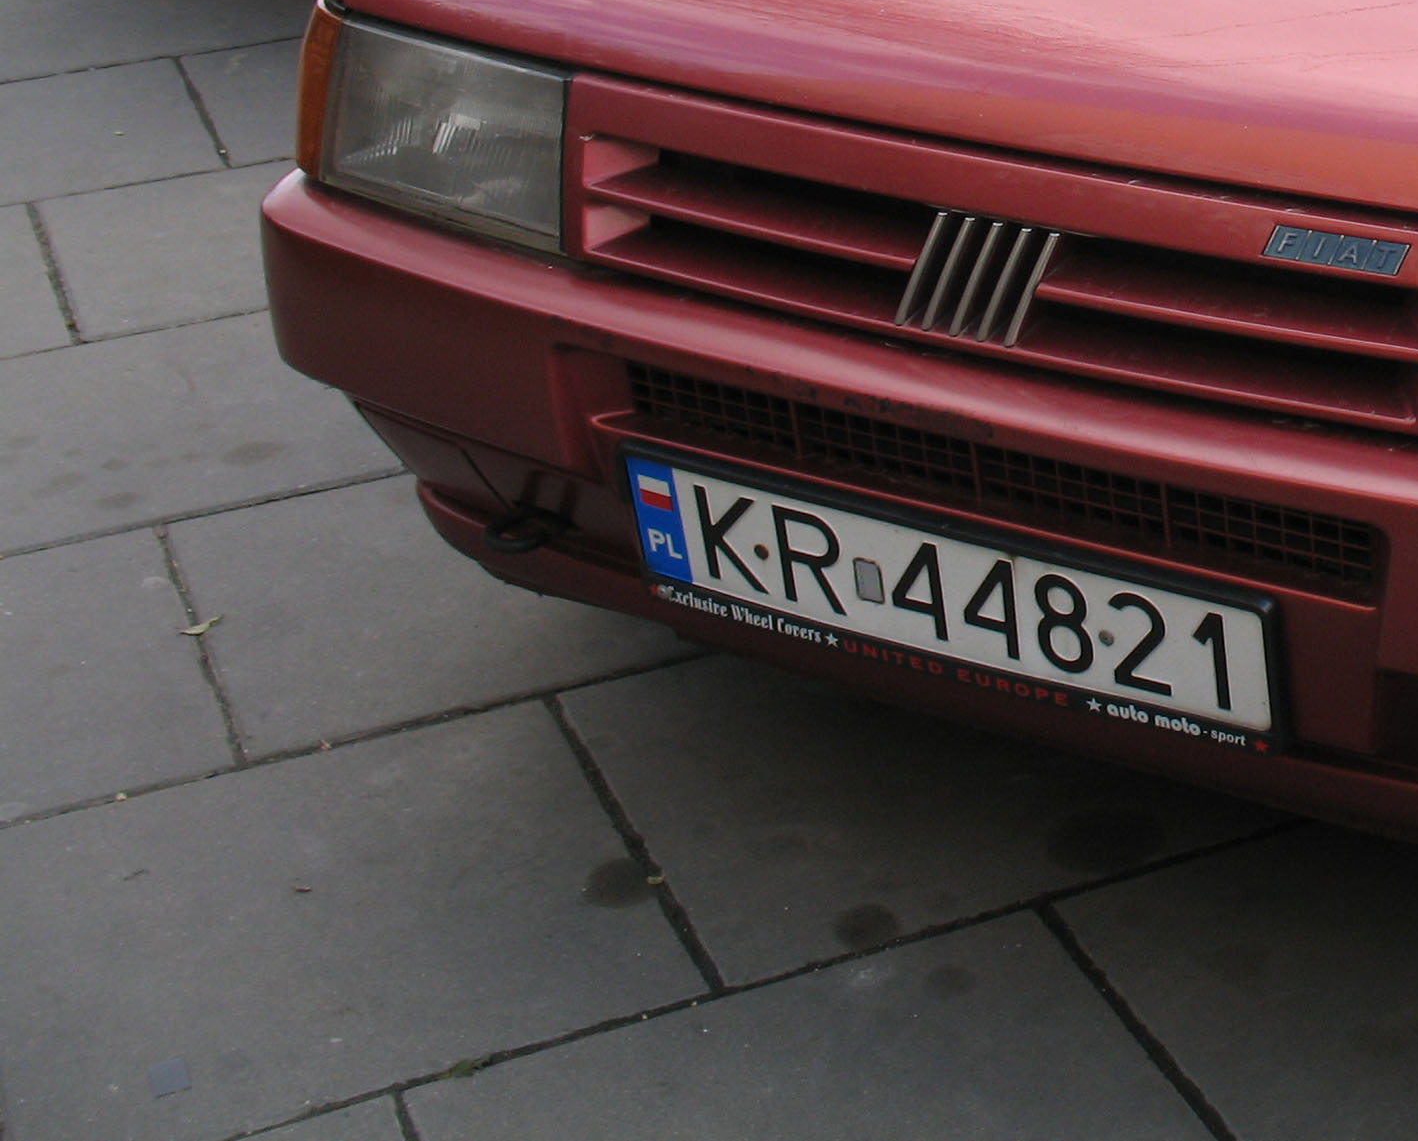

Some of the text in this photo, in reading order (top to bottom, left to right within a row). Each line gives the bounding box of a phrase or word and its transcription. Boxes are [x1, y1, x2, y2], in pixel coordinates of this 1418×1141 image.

[1277, 232, 1397, 269] FIAT
[648, 528, 683, 560] PL
[693, 484, 1231, 711] KR 44821
[667, 584, 728, 617] Exclusive
[732, 603, 773, 630] Wheel
[777, 618, 822, 643] Covers
[842, 639, 944, 675] UNITED
[957, 668, 1069, 706] EUROPE
[1107, 703, 1149, 723] auto
